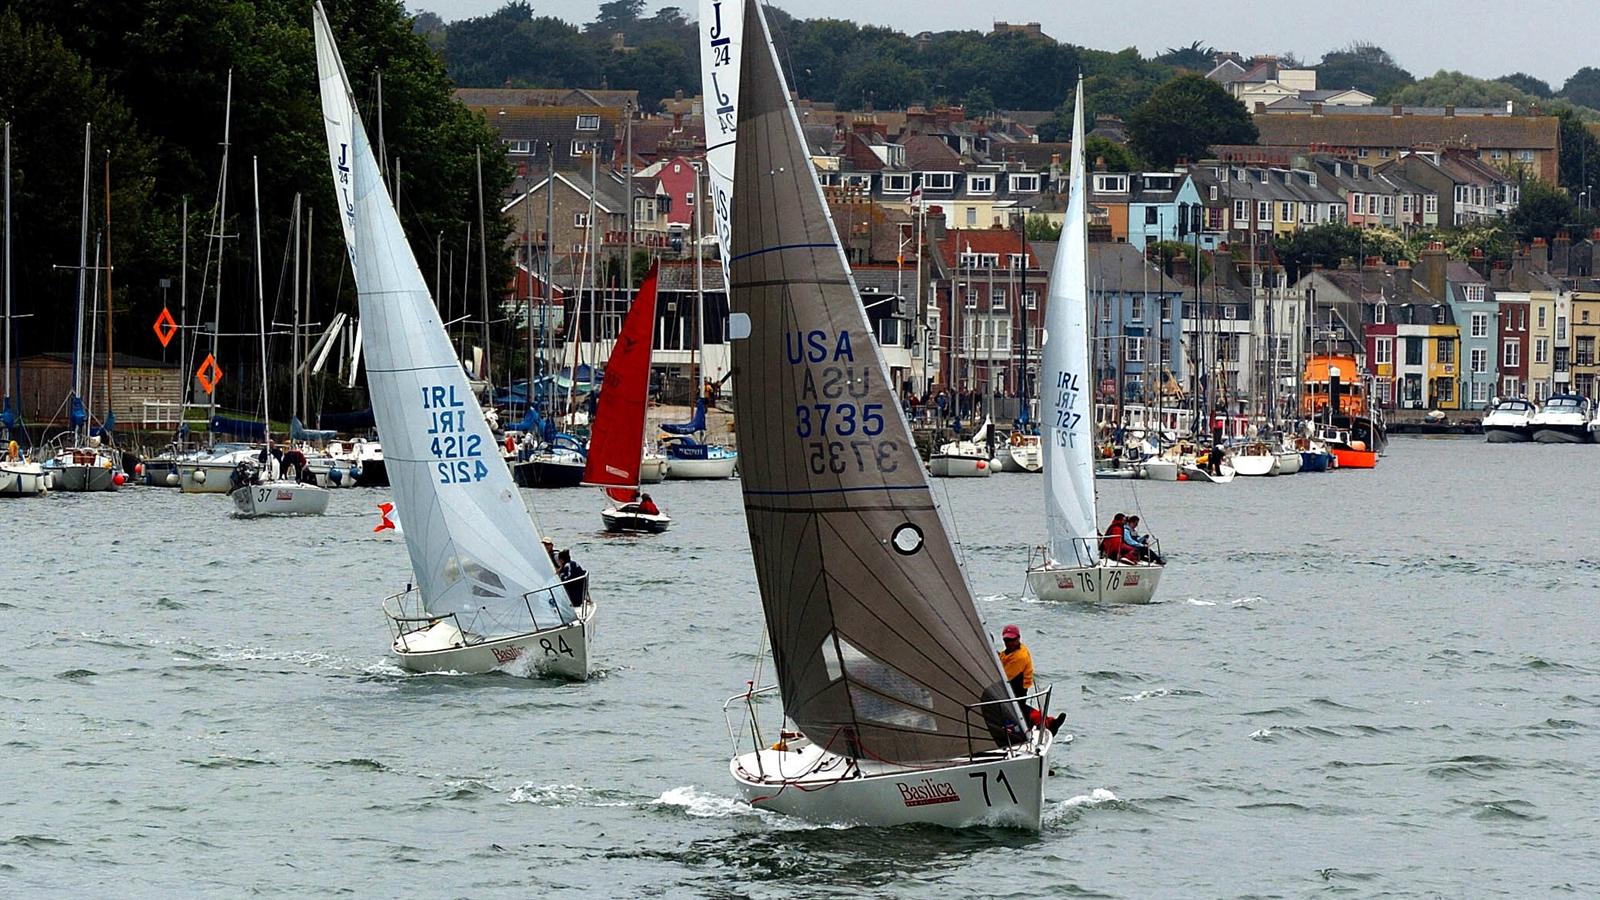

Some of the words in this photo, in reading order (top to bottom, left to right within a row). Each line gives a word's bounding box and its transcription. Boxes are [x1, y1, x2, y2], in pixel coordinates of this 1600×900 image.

[709, 2, 722, 39] J
[714, 45, 731, 67] 24
[338, 143, 348, 166] J
[786, 330, 854, 365] USA
[1056, 371, 1080, 392] IRL
[421, 385, 464, 409] IRL
[796, 403, 884, 439] 3735
[1056, 410, 1082, 430] 727
[430, 434, 482, 459] 4212
[257, 488, 272, 503] 37
[1077, 572, 1095, 593] 76
[1106, 570, 1122, 591] 76
[540, 634, 575, 662] 84
[896, 777, 957, 802] Basilica
[968, 768, 1018, 807] 71
